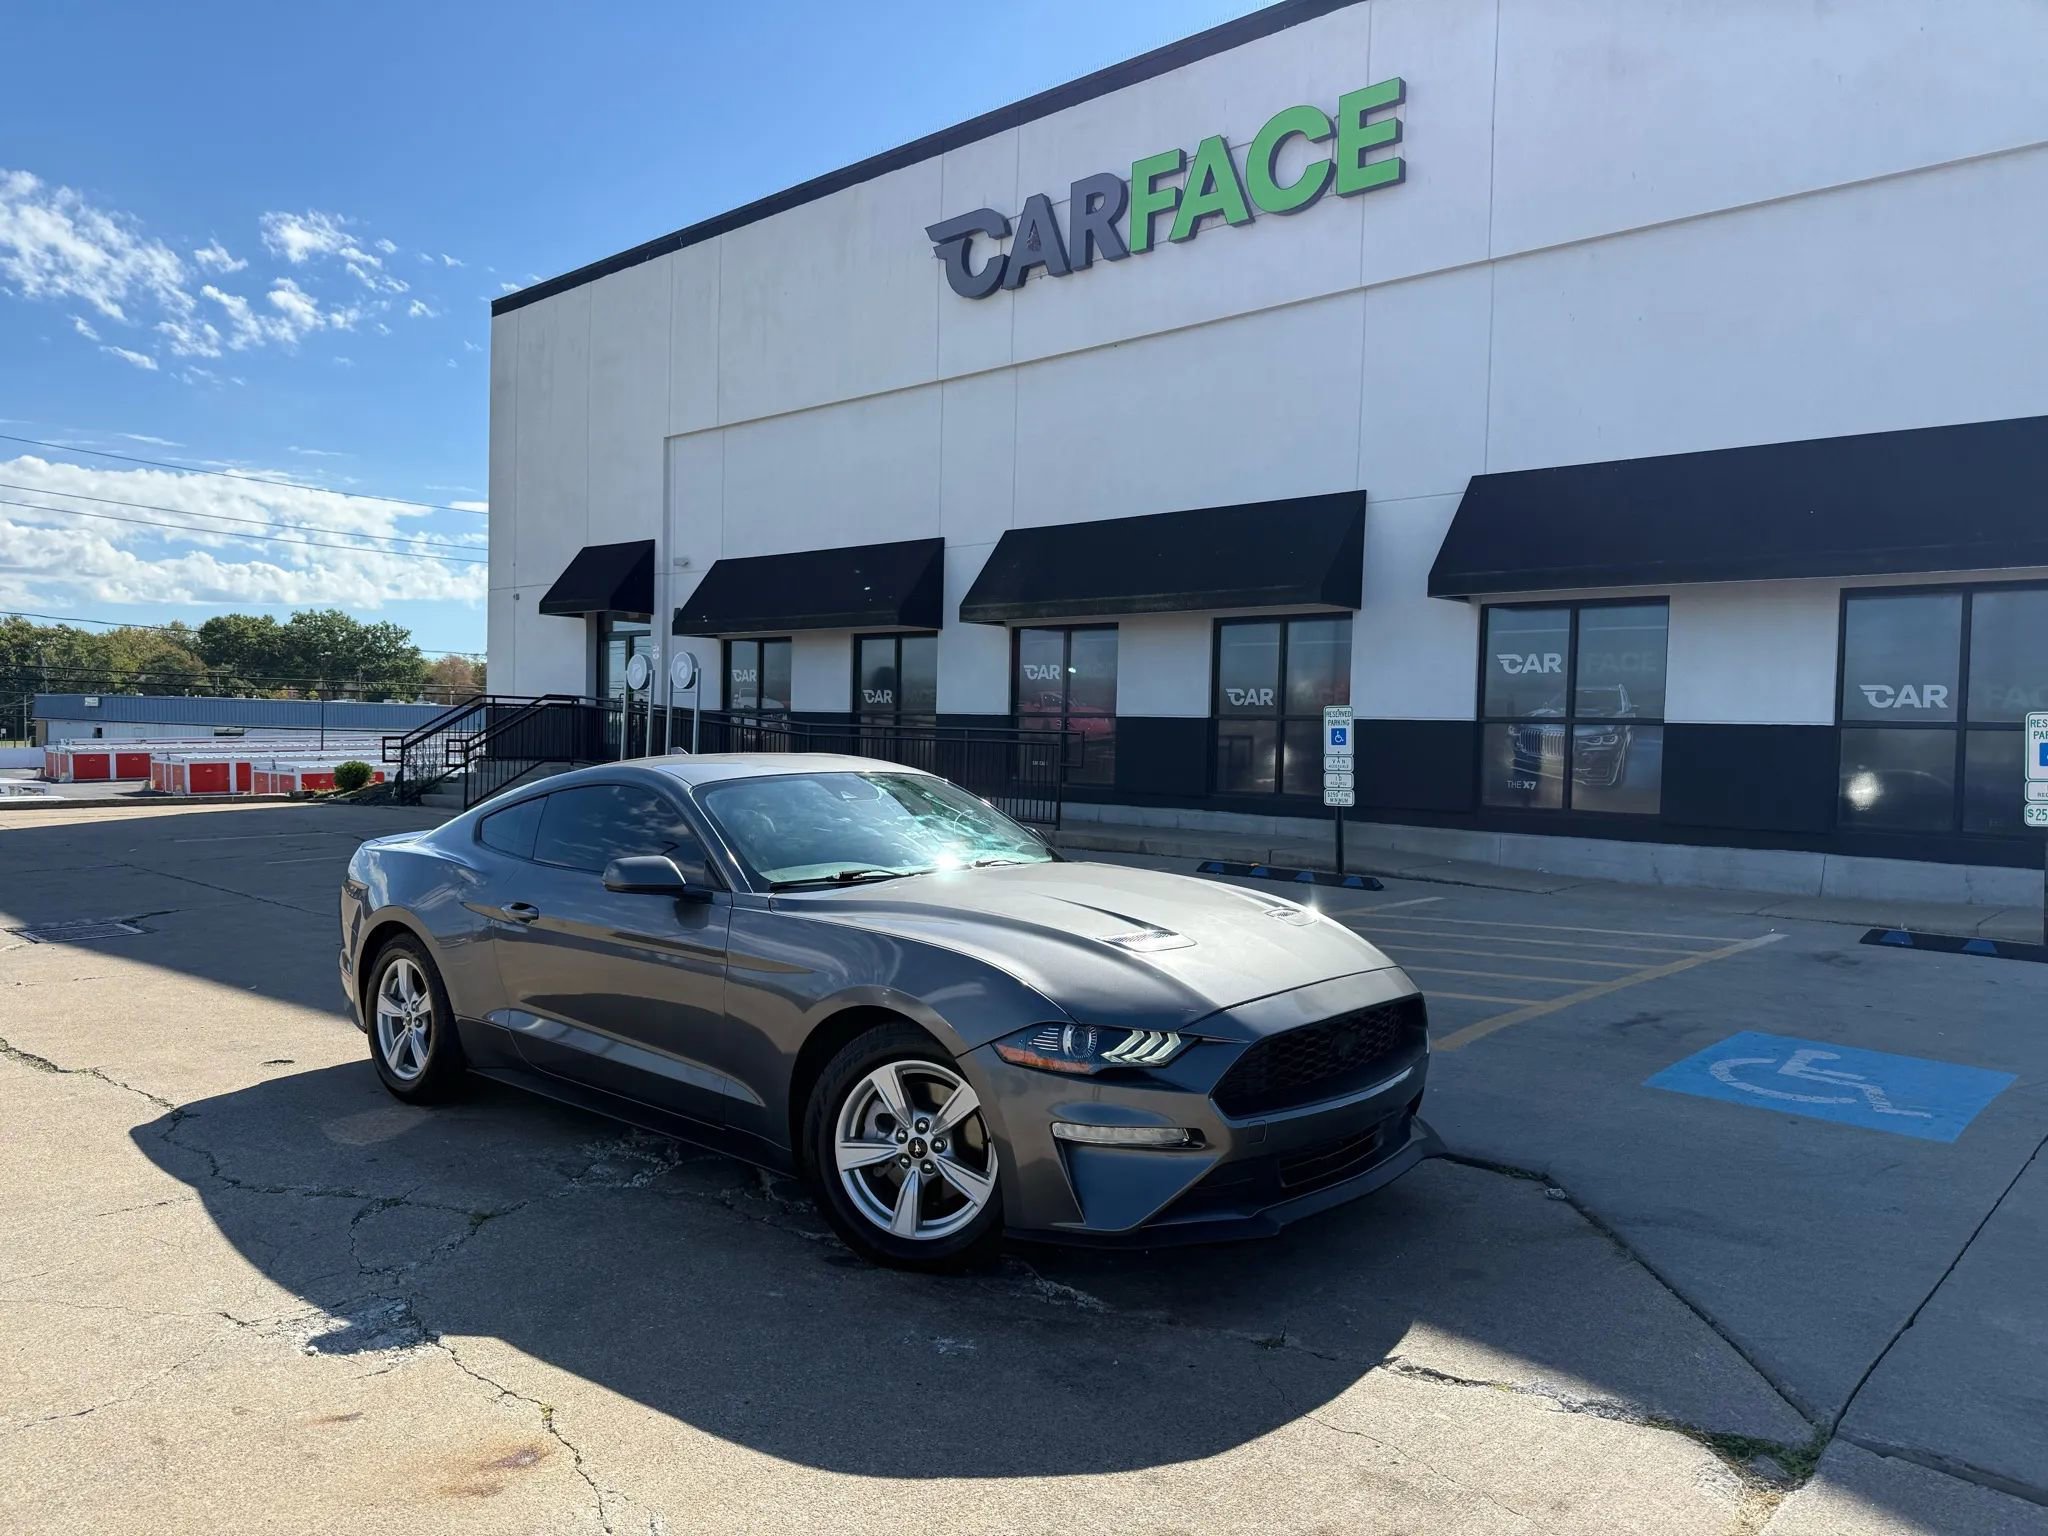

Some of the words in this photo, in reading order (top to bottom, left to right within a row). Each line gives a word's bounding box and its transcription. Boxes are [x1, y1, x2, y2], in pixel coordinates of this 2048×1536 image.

[1496, 653, 1562, 674] CAR
[731, 669, 757, 682] CAR
[1023, 664, 1061, 680] CAR
[862, 689, 893, 704] CAR
[1225, 688, 1274, 706] CAR
[1859, 684, 1948, 709] CAR
[1326, 710, 1352, 718] RESERVED
[1327, 719, 1350, 727] PARKING
[1506, 780, 1522, 789] THE
[1522, 781, 1537, 790] X7
